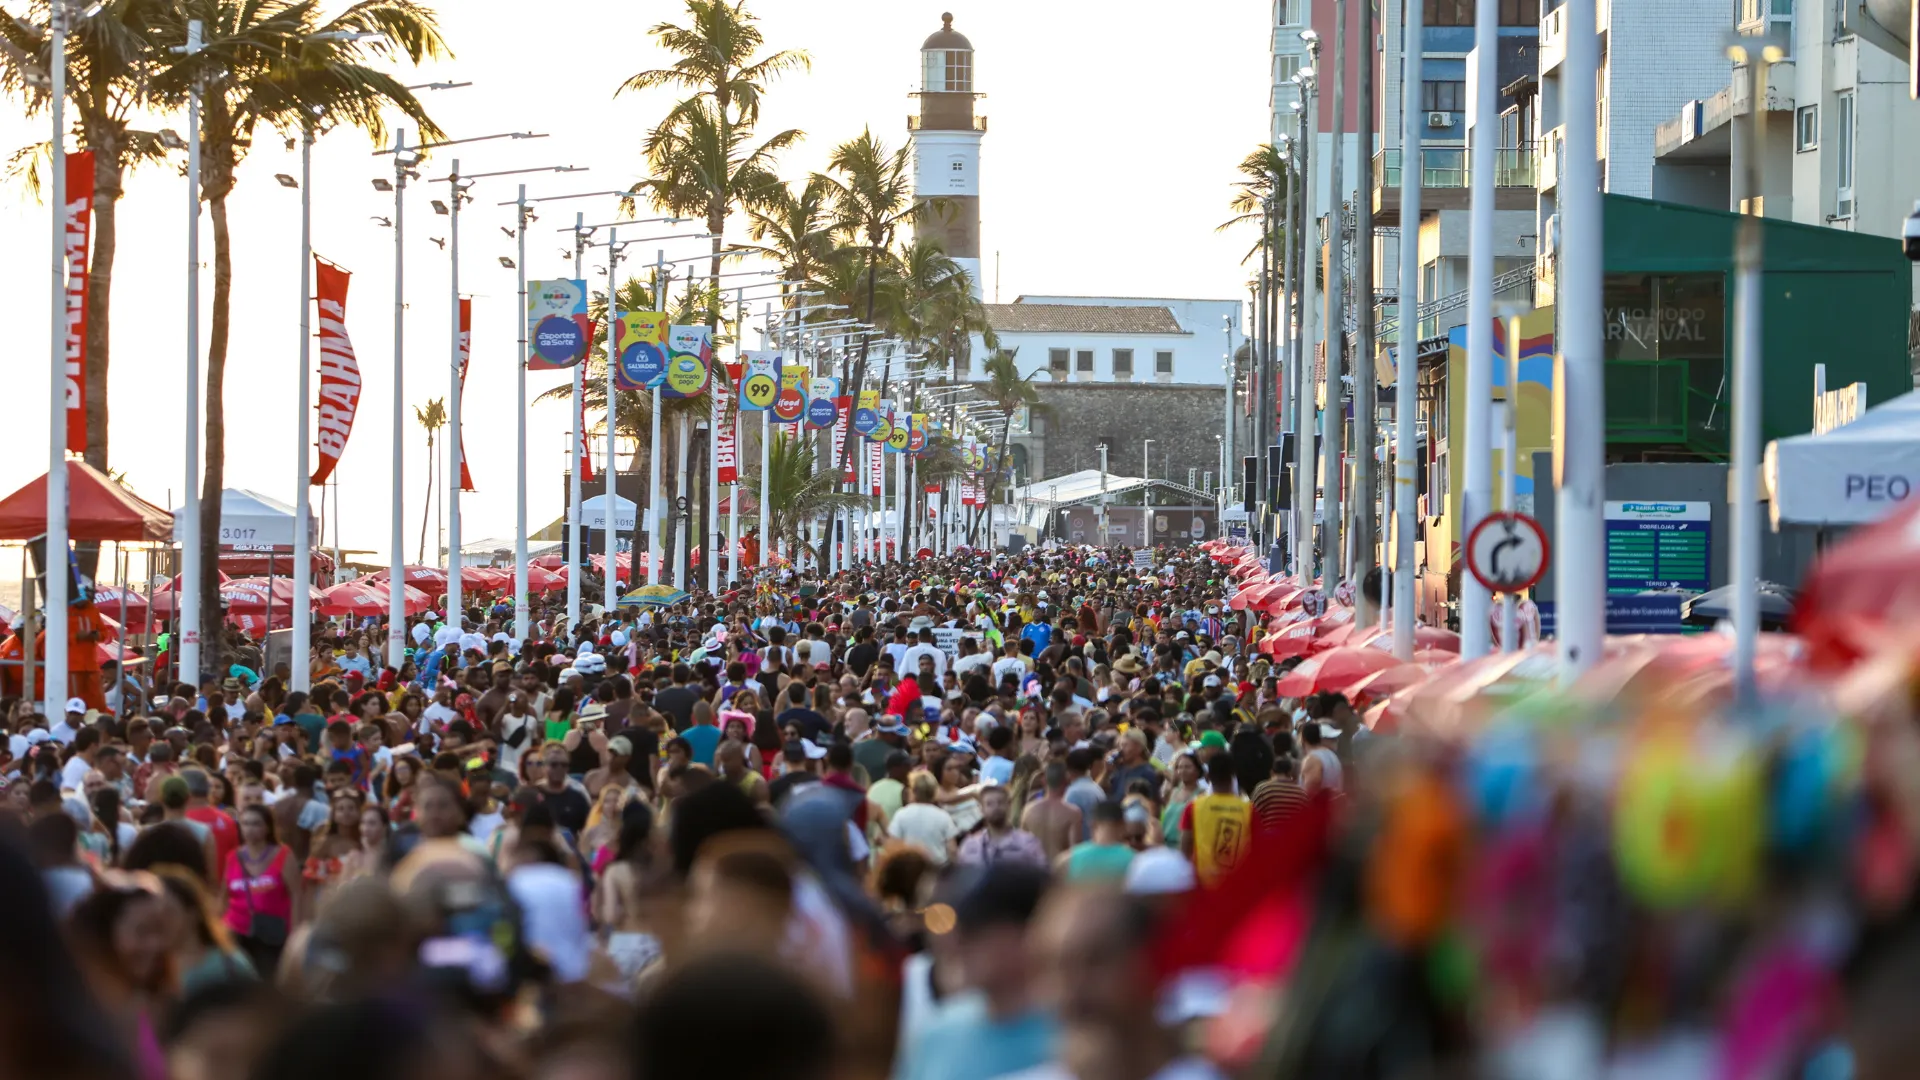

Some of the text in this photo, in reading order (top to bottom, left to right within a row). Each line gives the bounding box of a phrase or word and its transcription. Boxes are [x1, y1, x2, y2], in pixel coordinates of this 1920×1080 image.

[538, 332, 576, 341] Esportes
[318, 298, 362, 460] BRAHMA
[751, 383, 770, 397] 99
[892, 433, 904, 443] 99
[1846, 474, 1910, 501] PEO
